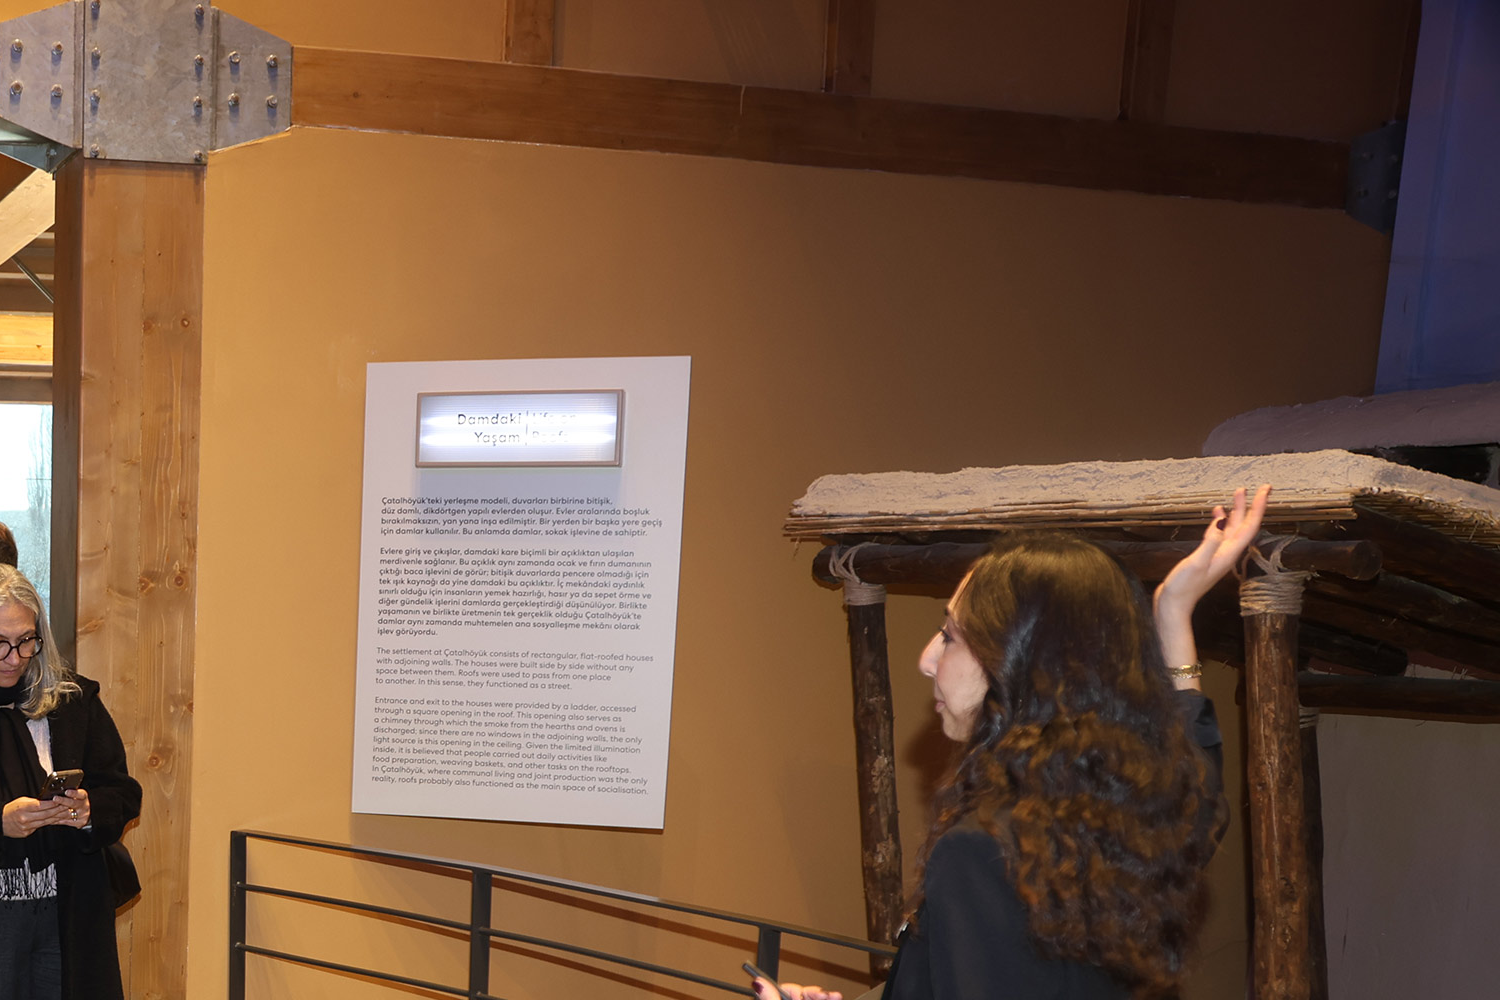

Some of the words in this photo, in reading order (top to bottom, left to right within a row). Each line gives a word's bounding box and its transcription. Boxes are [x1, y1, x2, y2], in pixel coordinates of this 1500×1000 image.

[457, 412, 522, 425] Damdaki
[474, 431, 520, 446] Yaşam
[443, 497, 479, 506] yerleşme
[422, 506, 466, 516] dikdörtgen
[467, 507, 490, 516] yapılı
[622, 508, 650, 516] boşluk
[480, 517, 497, 526] inşa
[551, 518, 580, 526] yerden
[594, 518, 620, 526] başka
[641, 518, 662, 527] geçiş
[380, 526, 394, 536] için
[395, 526, 424, 534] damlar
[512, 528, 543, 536] damlar,
[544, 526, 568, 535] sokak
[570, 528, 600, 537] işlevine
[614, 527, 647, 537] sahiptir.
[404, 547, 421, 556] giriş
[520, 548, 546, 557] biçimli
[560, 549, 600, 558] açıklıktan
[602, 550, 634, 558] ulaşılan
[379, 556, 422, 565] merdivenle
[470, 558, 496, 567] açıklık
[379, 567, 402, 576] çıktığı
[424, 567, 451, 576] işlevini
[464, 568, 489, 577] görür;
[490, 568, 514, 577] bitişik
[515, 568, 560, 577] duvarlarda
[596, 570, 633, 579] olmadığı
[634, 570, 649, 579] için
[378, 576, 391, 584] tek
[392, 577, 405, 586] ışık
[406, 576, 438, 586] kaynağı
[451, 577, 468, 587] yine
[556, 578, 564, 588] İç
[612, 579, 645, 589] aydınlık
[400, 588, 427, 596] olduğu
[428, 586, 442, 596] için
[444, 587, 483, 596] insanların
[484, 589, 510, 597] yemek
[618, 589, 640, 598] örme
[378, 597, 398, 606] diğer
[399, 597, 433, 606] gündelik
[434, 598, 460, 607] işlerini
[461, 598, 501, 606] damlarda
[618, 601, 647, 609] Birlikte
[517, 610, 553, 619] gerçeklik
[554, 610, 583, 620] olduğu
[377, 616, 406, 624] damlar
[532, 619, 580, 630] sosyalleşme
[613, 620, 640, 630] olarak
[377, 627, 394, 636] işlev
[395, 628, 437, 637] görüyordu.
[443, 648, 487, 658] Çatalhöyük
[530, 652, 578, 660] rectangular,
[580, 652, 624, 660] flat-roofed
[394, 658, 430, 667] adjoining
[470, 659, 497, 667] houses
[556, 662, 567, 670] by
[399, 666, 433, 675] between
[458, 668, 479, 676] Roofs
[551, 670, 570, 679] from
[589, 673, 611, 681] place
